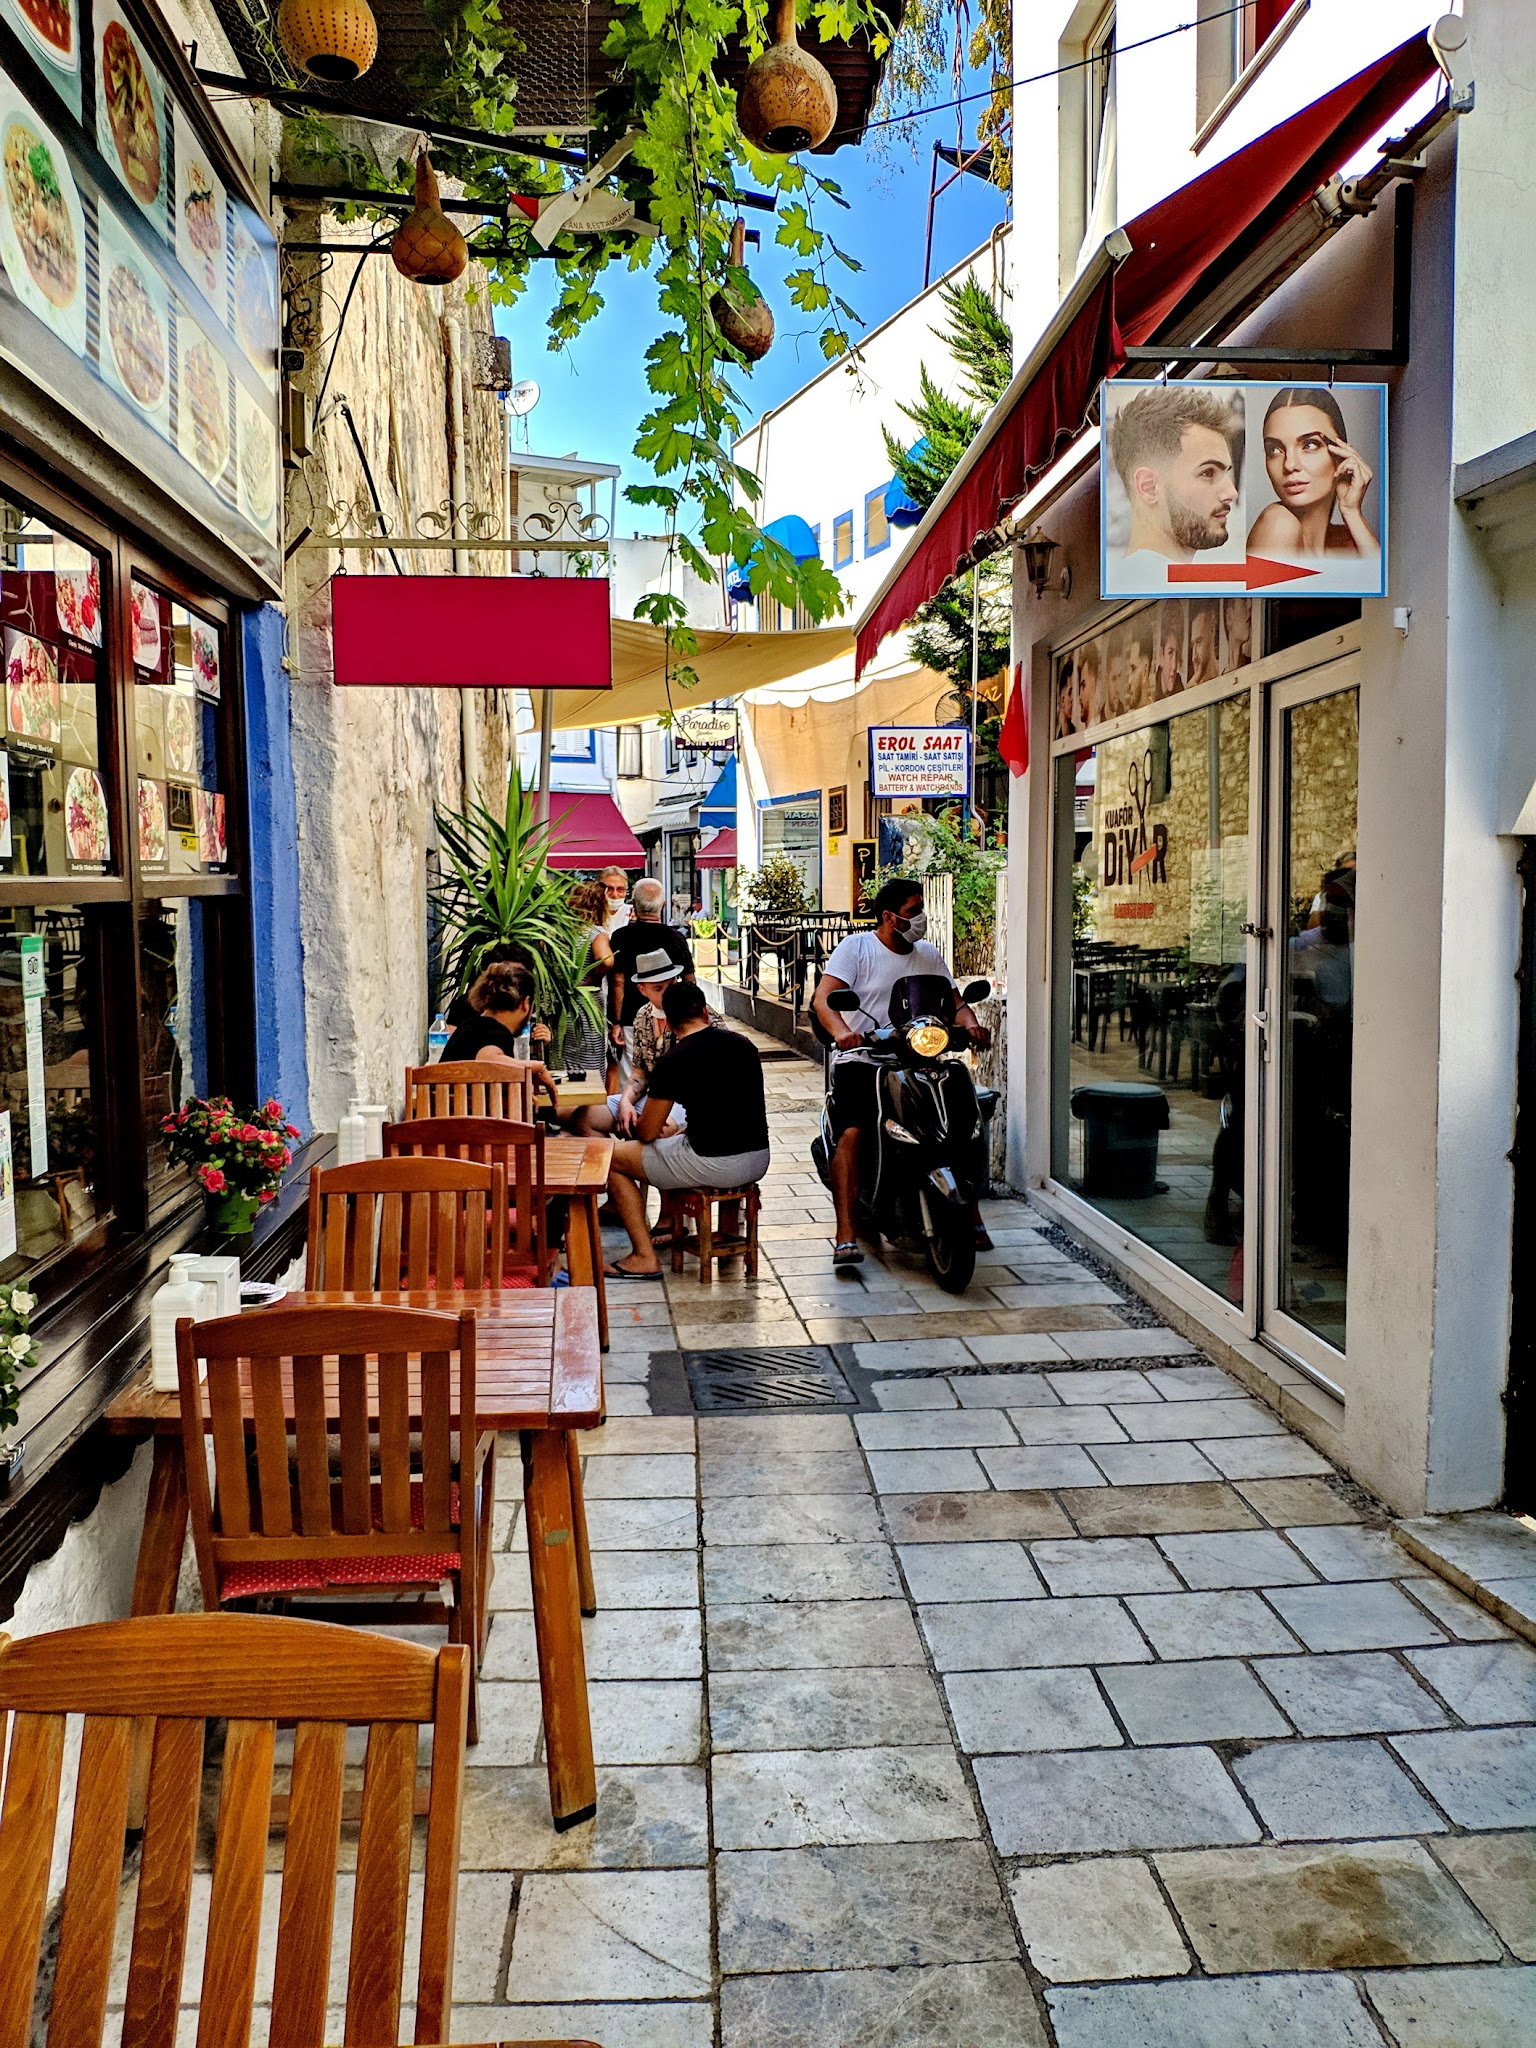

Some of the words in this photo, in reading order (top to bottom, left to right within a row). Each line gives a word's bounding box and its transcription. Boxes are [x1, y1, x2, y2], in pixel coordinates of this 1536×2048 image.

[586, 208, 631, 230] RESTAURANT
[680, 714, 731, 731] Paradise
[878, 736, 916, 751] EROL
[923, 736, 962, 750] SAAT
[878, 752, 894, 761] SAAT
[896, 751, 918, 761] TAMİRİ
[924, 752, 941, 761] SAAT
[943, 752, 964, 762] SATIŞI
[878, 763, 890, 772] PİL
[895, 764, 925, 772] KORDON
[888, 773, 918, 782] WATCH
[921, 773, 954, 782] REPAIR
[879, 784, 908, 792] BATTERY
[909, 784, 914, 792] &
[916, 783, 963, 792] WATCHBANDS
